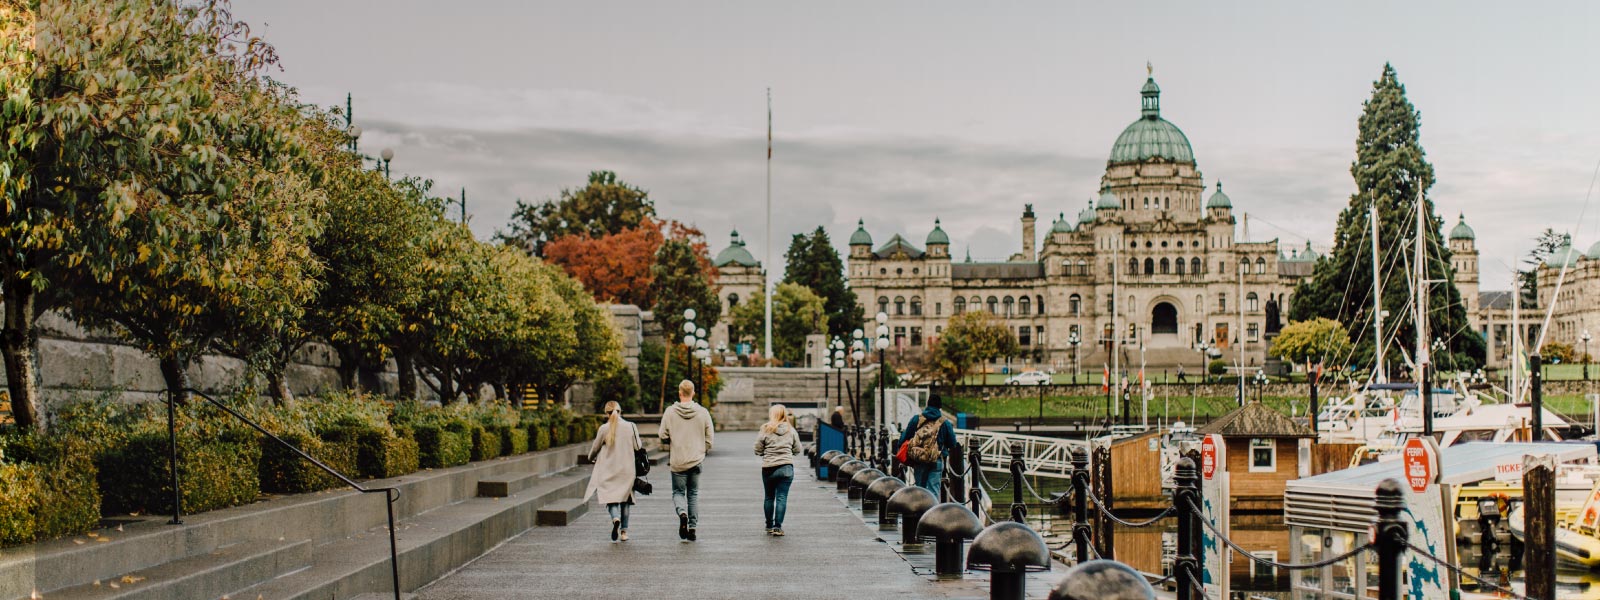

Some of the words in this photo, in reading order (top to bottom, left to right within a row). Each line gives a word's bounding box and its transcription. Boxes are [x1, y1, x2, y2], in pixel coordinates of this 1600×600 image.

[1407, 448, 1424, 457] FERRY
[1496, 463, 1521, 473] TICKE
[1411, 478, 1425, 487] STOP
